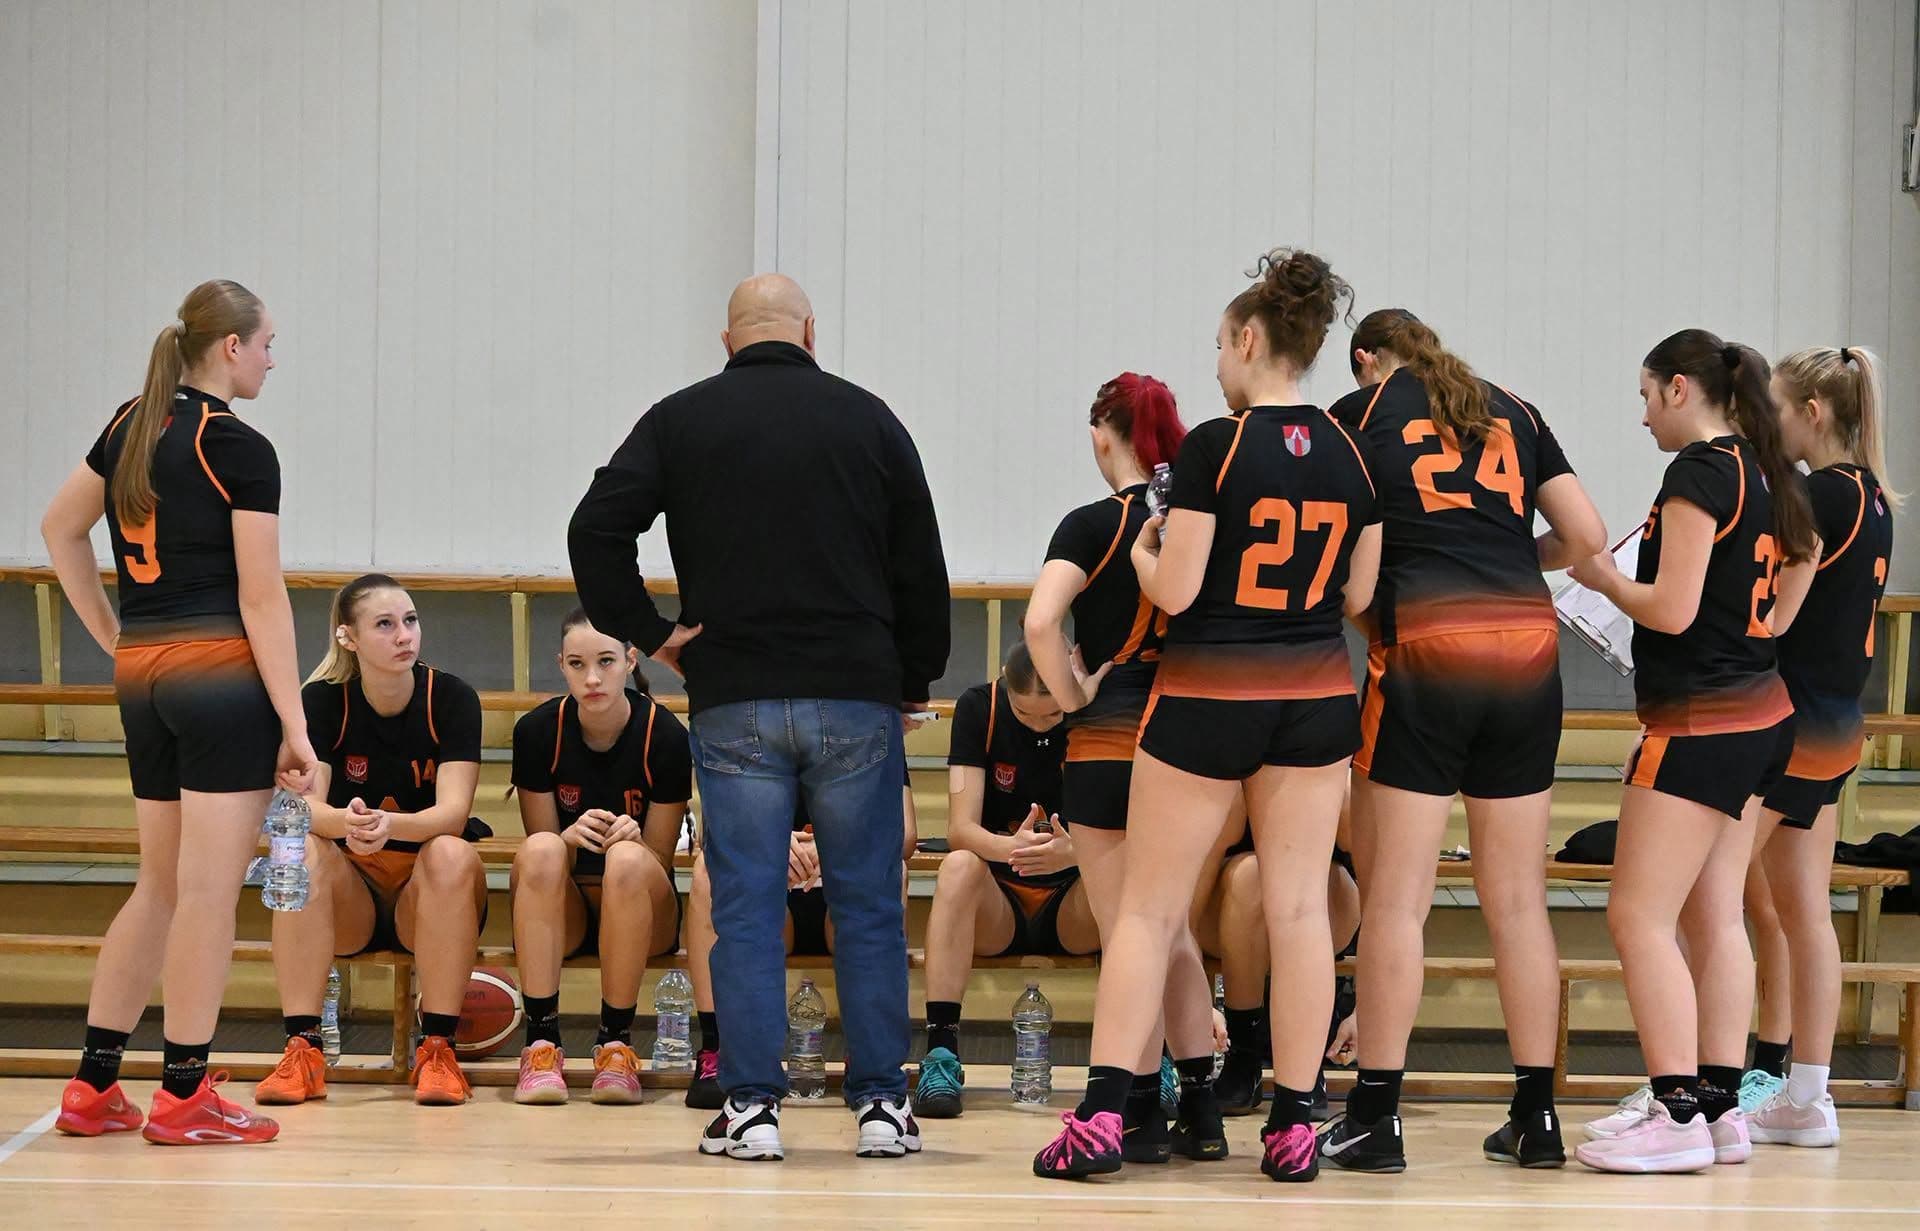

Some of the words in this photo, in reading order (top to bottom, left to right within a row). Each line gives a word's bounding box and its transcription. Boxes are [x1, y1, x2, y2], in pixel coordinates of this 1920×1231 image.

[1401, 417, 1525, 518] 24
[1235, 497, 1348, 611] 27
[1745, 532, 1784, 638] 2
[410, 758, 437, 788] 14
